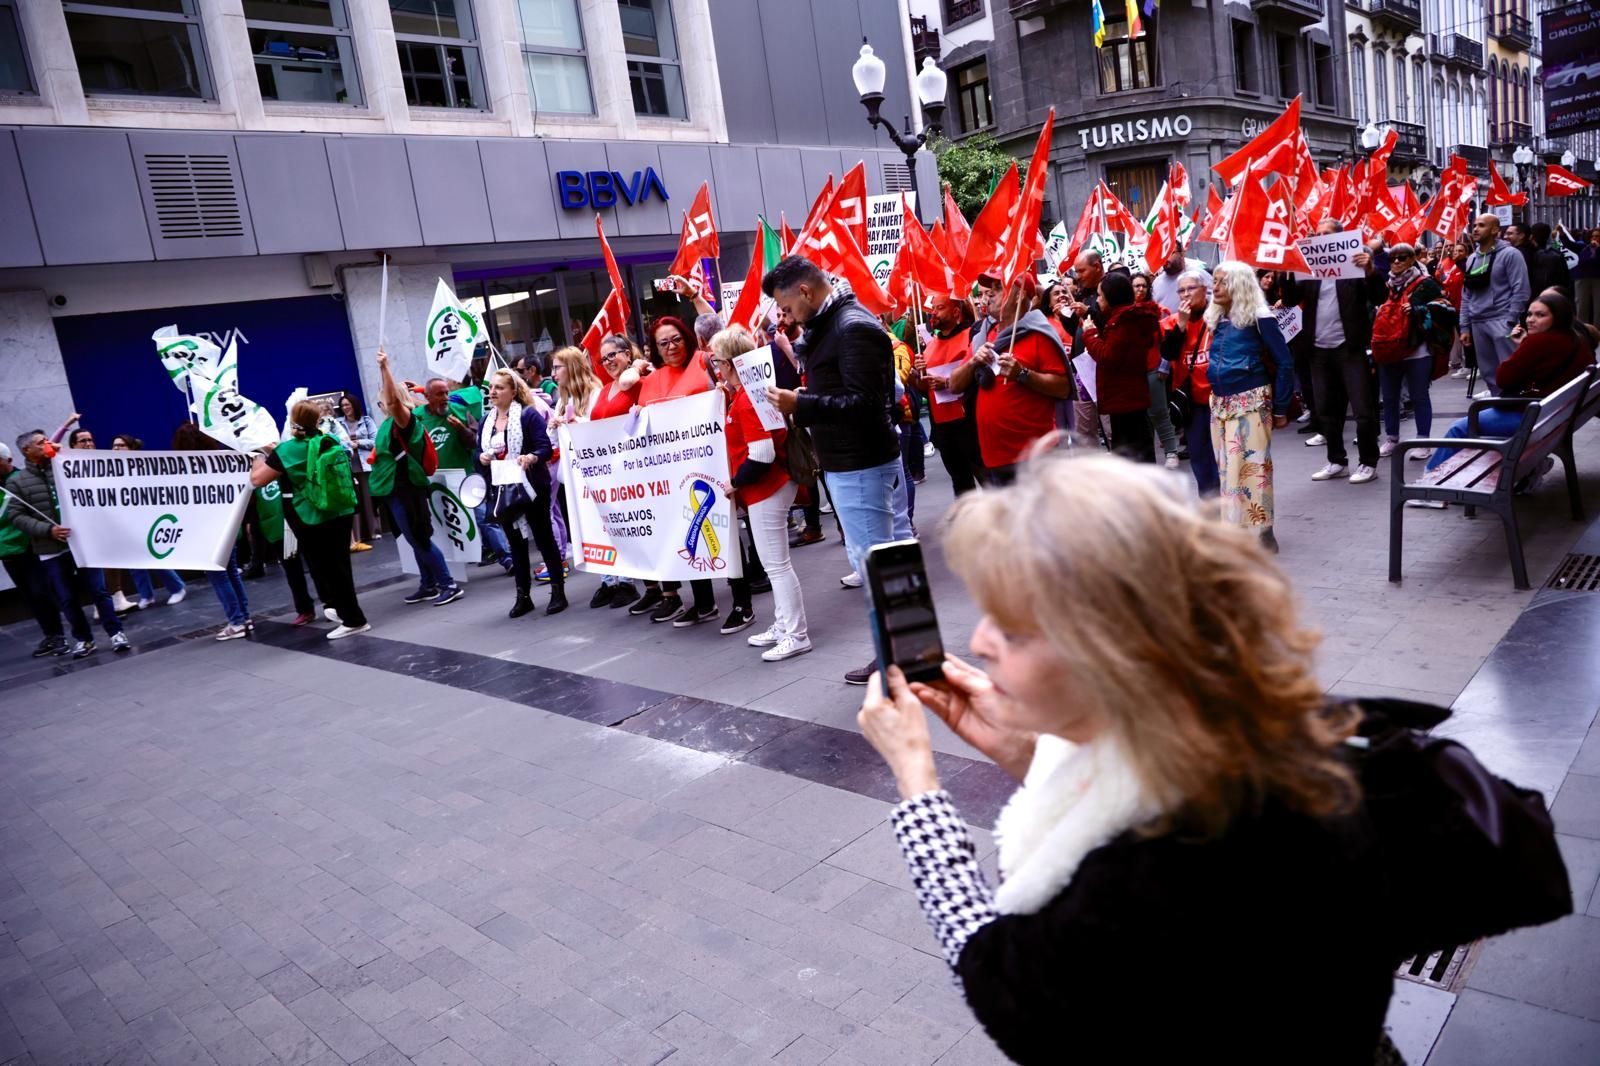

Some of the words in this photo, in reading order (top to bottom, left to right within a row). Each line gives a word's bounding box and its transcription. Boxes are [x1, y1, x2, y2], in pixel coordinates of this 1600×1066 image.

[1078, 114, 1192, 149] TURISMO
[556, 166, 670, 209] BBVA
[873, 202, 881, 214] SI
[882, 201, 897, 213] HAY
[867, 217, 876, 228] RA
[877, 214, 903, 227] INVERT
[882, 228, 900, 241] PARA
[1301, 239, 1359, 256] ONVENIO
[1308, 254, 1347, 266] DIGNO
[1279, 313, 1296, 330] DIGNO
[431, 432, 450, 443] CSIF
[596, 446, 607, 457] de
[608, 444, 617, 455] la
[649, 431, 680, 447] PRIVADA
[681, 430, 689, 440] en
[690, 421, 722, 438] LUCHA
[62, 458, 125, 479] SANIDAD
[128, 456, 188, 477] PRIVADA
[190, 455, 208, 475] EN
[623, 460, 634, 471] Por
[636, 458, 643, 468] la
[644, 453, 671, 468] CALIDAD
[673, 451, 681, 462] del
[682, 445, 714, 461] SERVICIO
[70, 487, 95, 507] POR
[97, 487, 117, 507] UN
[120, 485, 190, 507] CONVENIO
[193, 484, 235, 505] DIGNO
[610, 486, 645, 502] DIGNO
[648, 480, 671, 497] YA!!
[154, 528, 183, 544] CSIF
[677, 548, 727, 572] DIGNO
